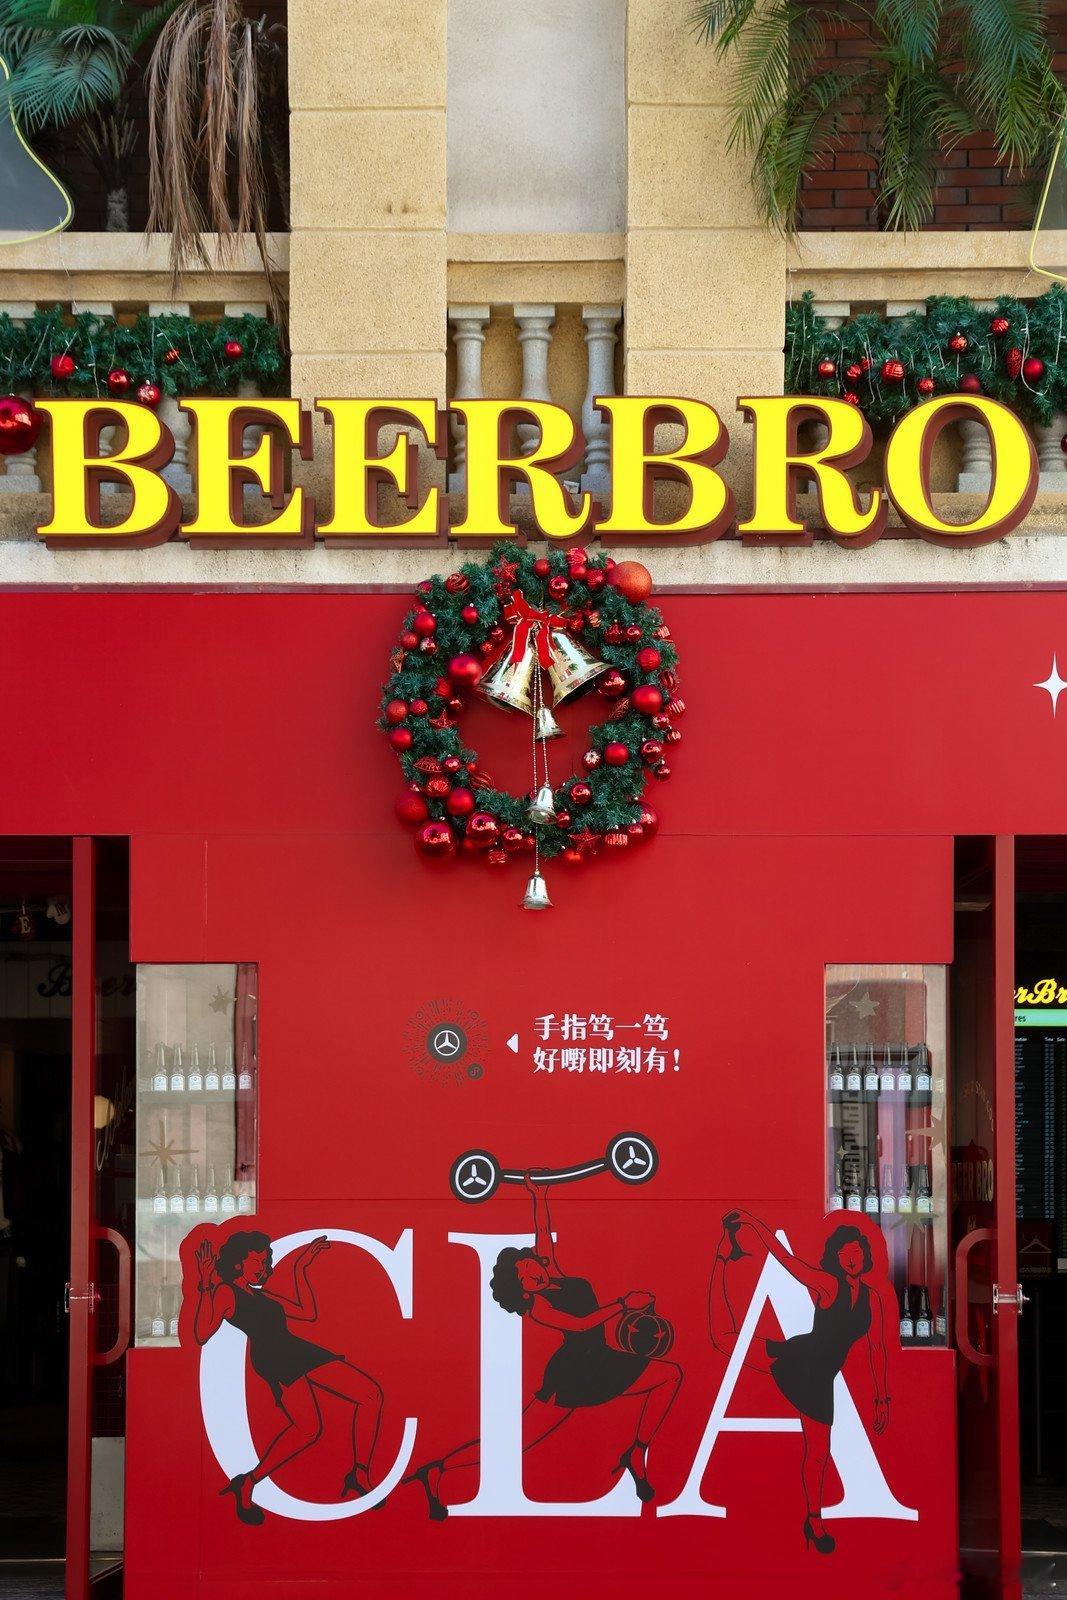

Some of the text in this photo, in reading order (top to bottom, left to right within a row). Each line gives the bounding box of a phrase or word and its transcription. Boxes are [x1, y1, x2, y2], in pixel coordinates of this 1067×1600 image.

[34, 395, 1037, 544] BEERBRO
[533, 1013, 669, 1041] 手指笃一笃
[1014, 978, 1067, 1004] rBr
[198, 1227, 920, 1522] CLA
